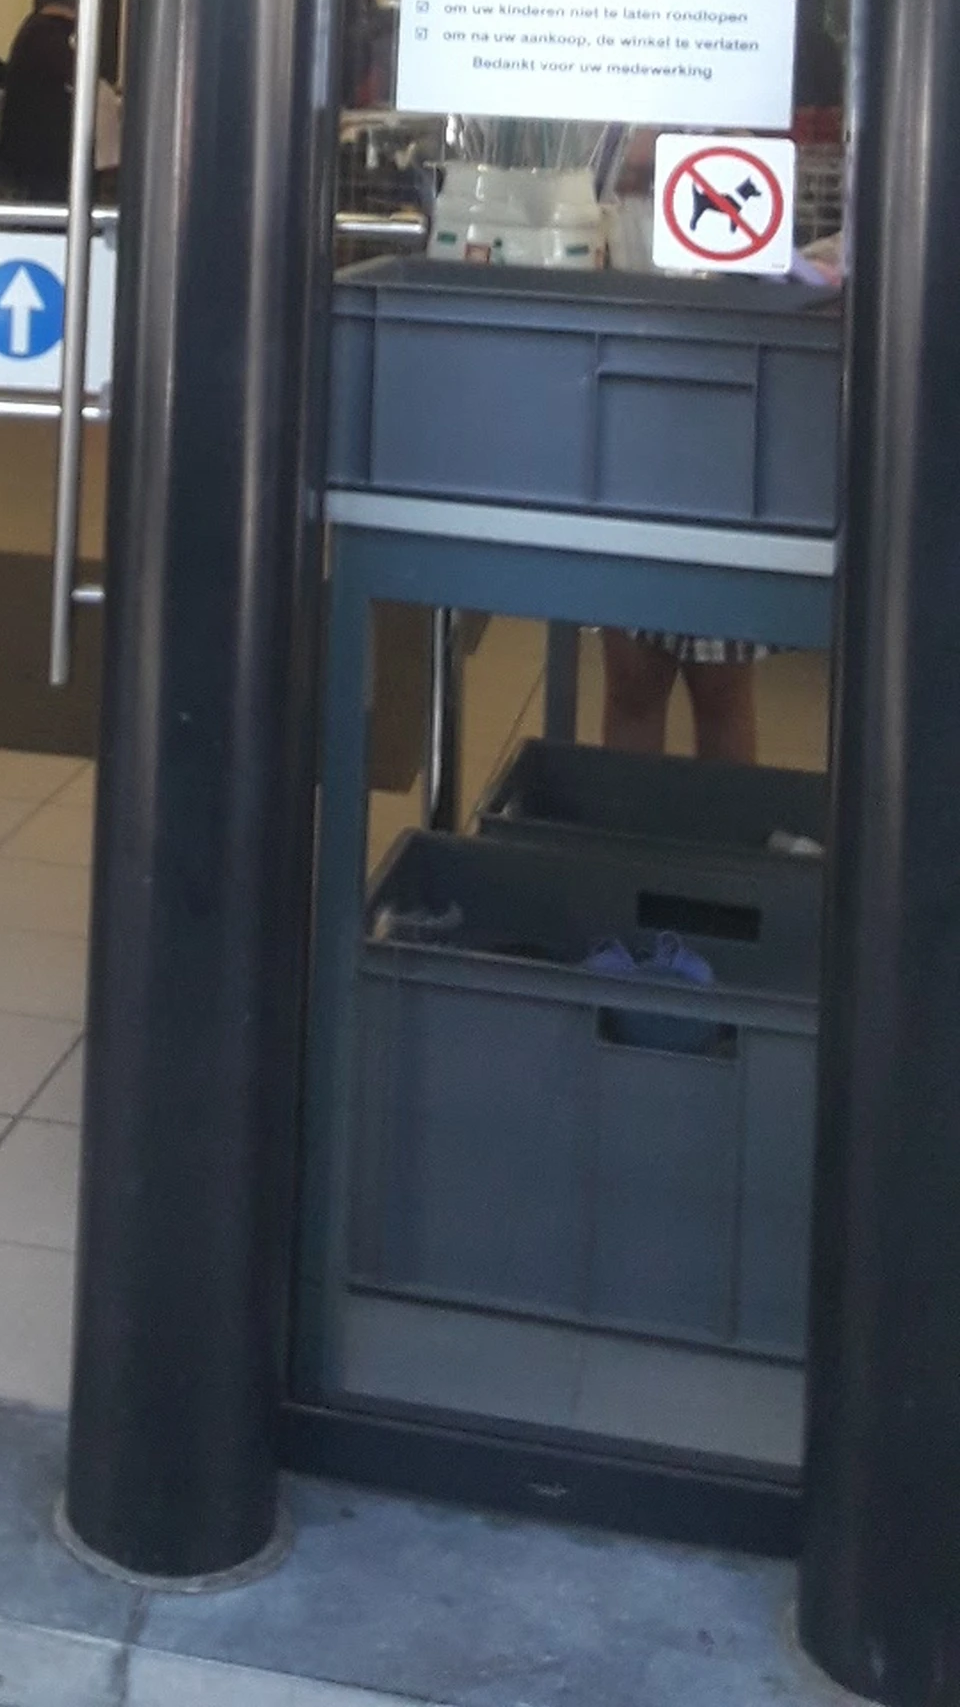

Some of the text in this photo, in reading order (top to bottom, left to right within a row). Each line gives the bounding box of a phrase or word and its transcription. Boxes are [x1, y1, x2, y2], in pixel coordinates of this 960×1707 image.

[443, 4, 748, 25] om uw kinderen niet te laten rondlopen
[443, 30, 759, 51] om na uw aankoop, de winkel te verlaten
[473, 56, 713, 81] Bedankt voor uw medewerking
